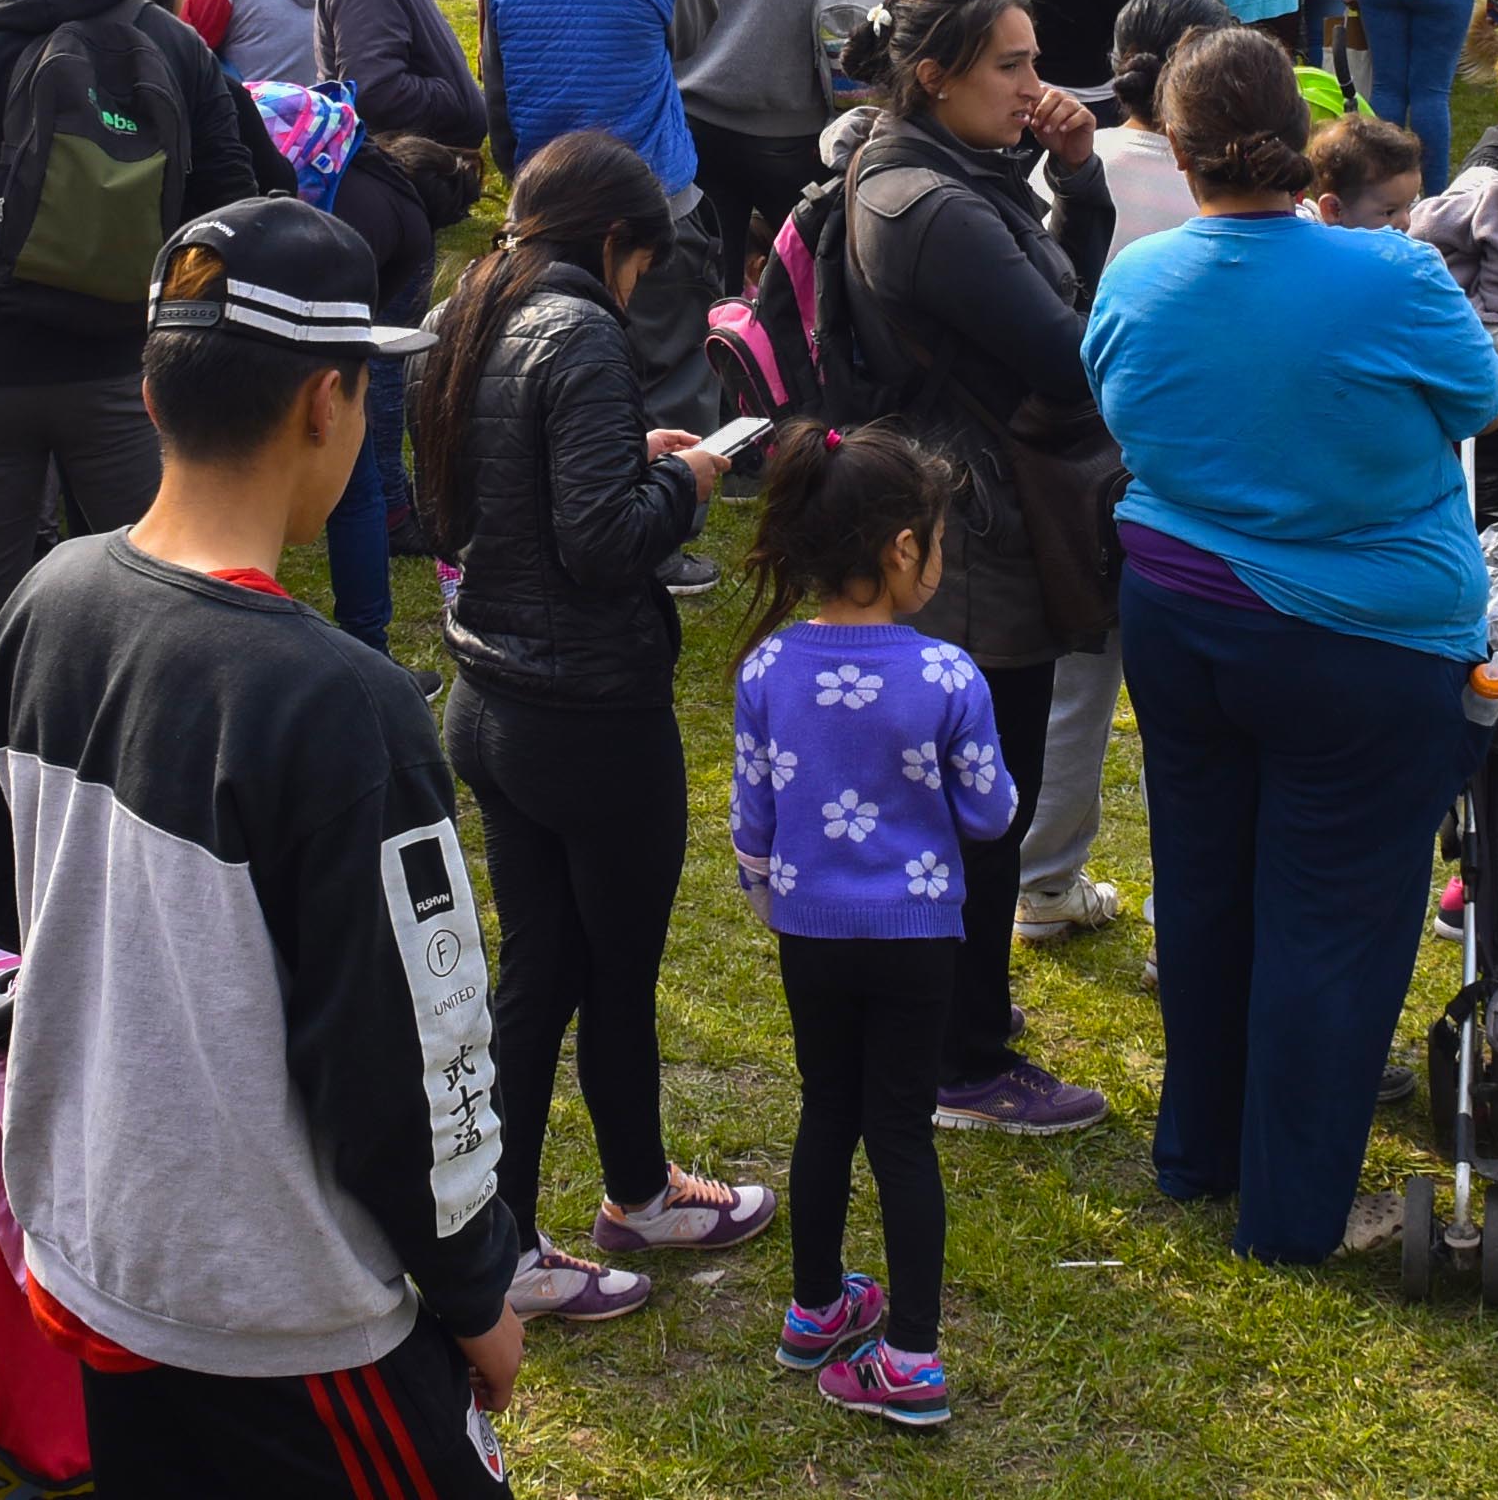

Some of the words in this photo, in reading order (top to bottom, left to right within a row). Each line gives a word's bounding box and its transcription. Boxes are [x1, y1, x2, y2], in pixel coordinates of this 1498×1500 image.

[416, 893, 450, 913] FLSHVN
[436, 938, 447, 967] F
[434, 985, 476, 1016] UNITED
[442, 1043, 483, 1161] 武士道
